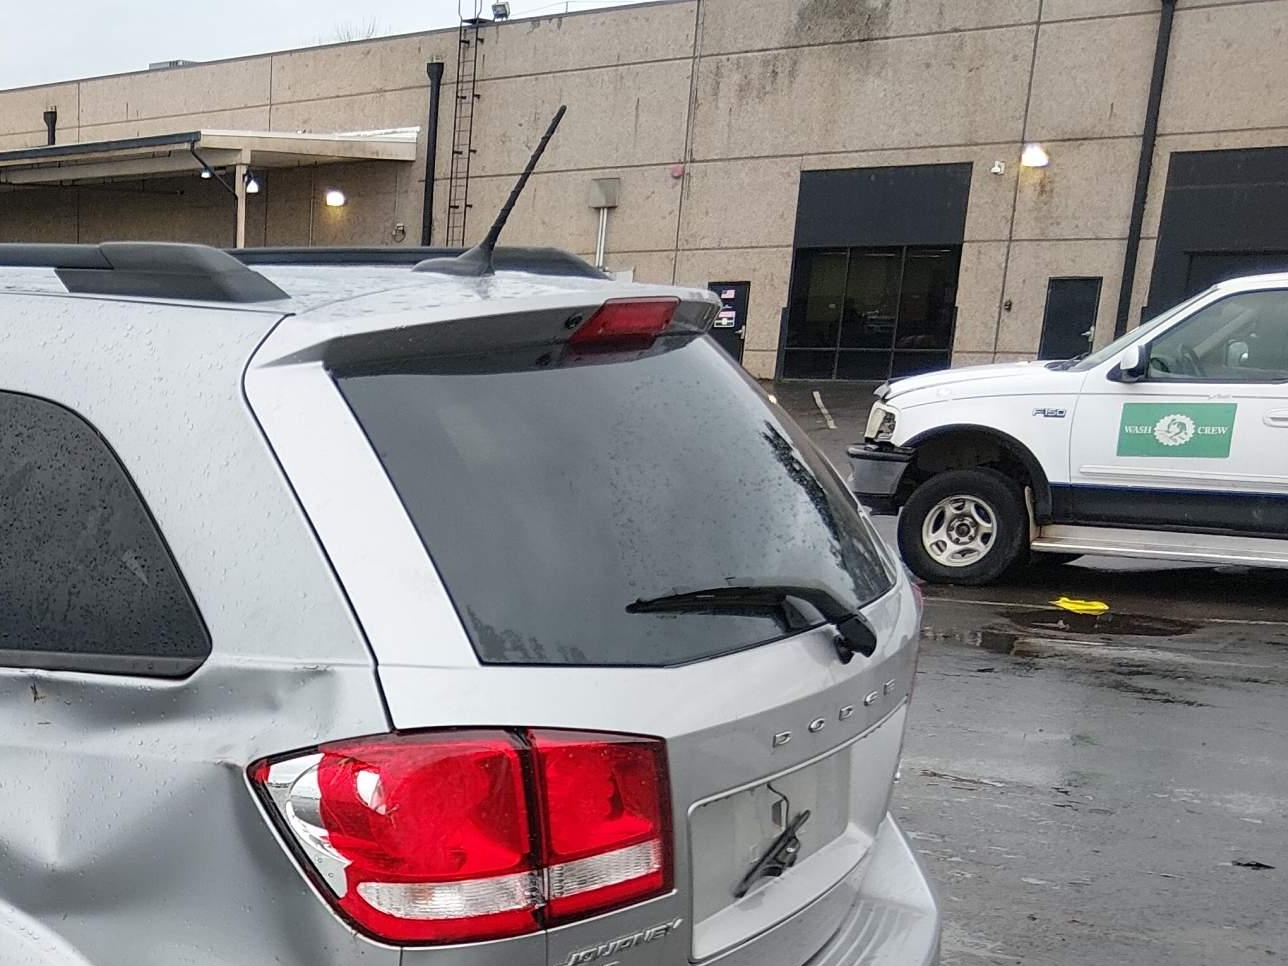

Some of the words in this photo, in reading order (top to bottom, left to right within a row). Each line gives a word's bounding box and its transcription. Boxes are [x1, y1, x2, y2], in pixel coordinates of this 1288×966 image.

[1124, 425, 1152, 434] WASH
[1197, 426, 1228, 435] CREW
[772, 679, 896, 748] DODGE
